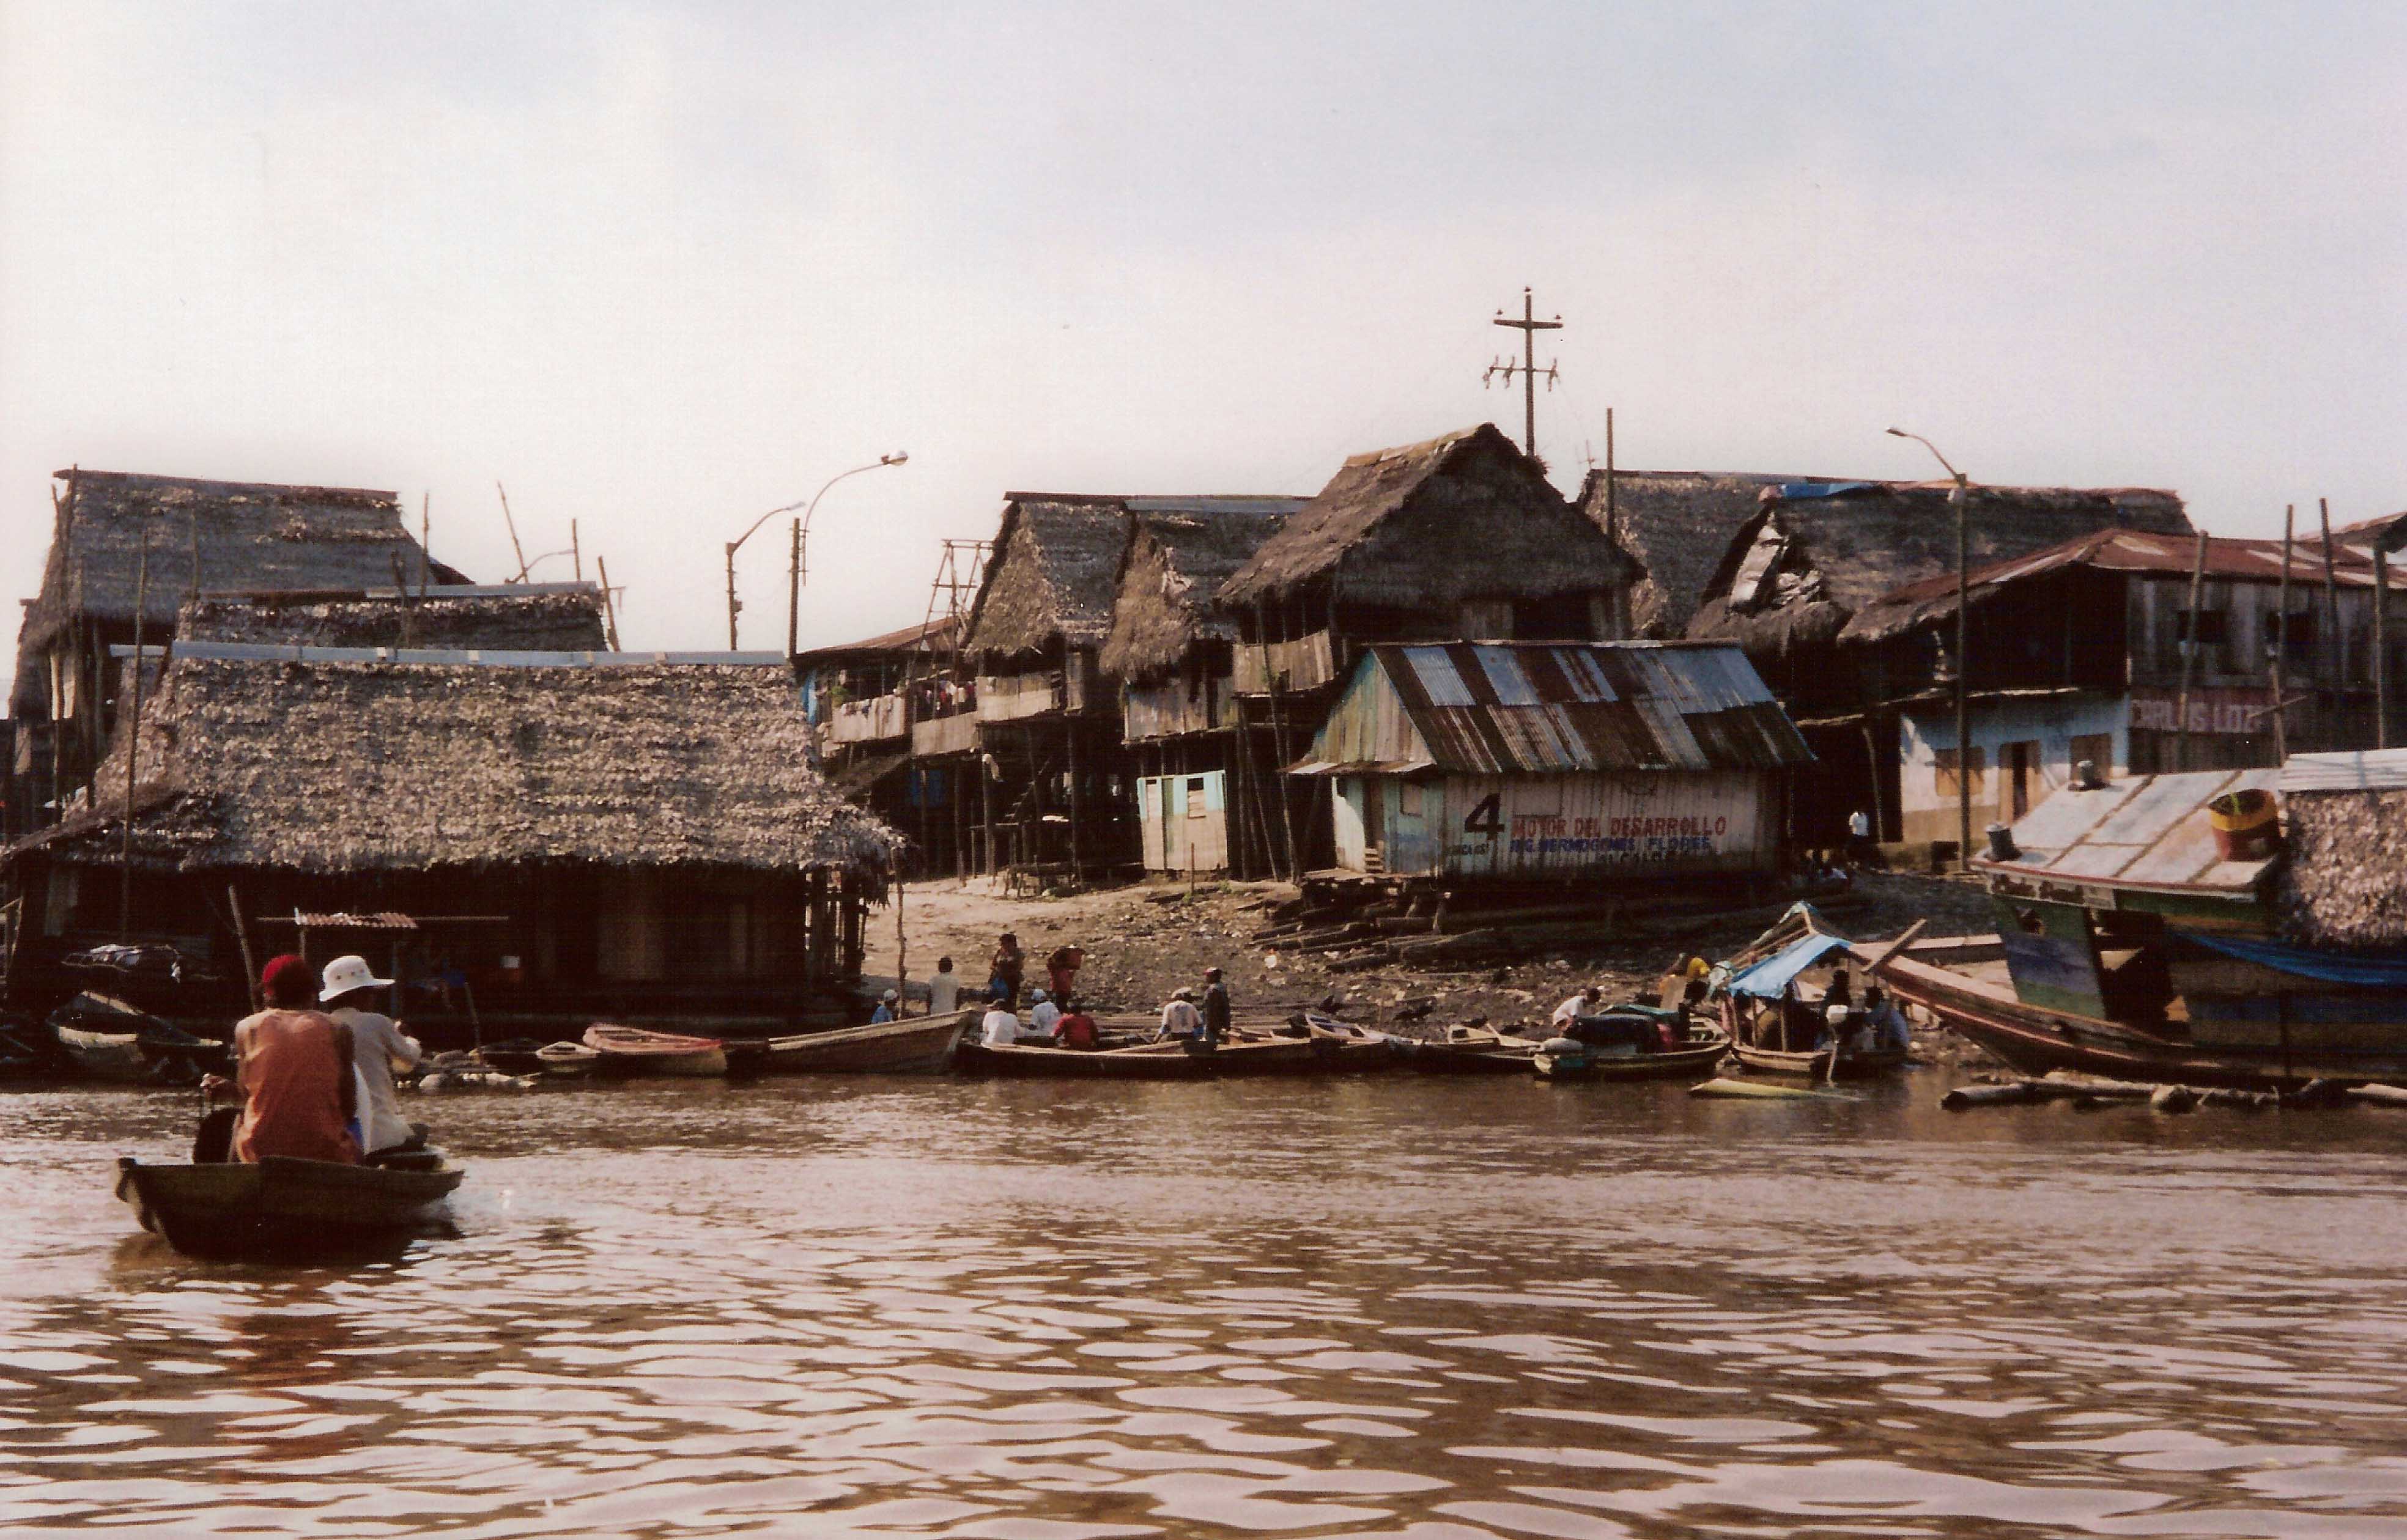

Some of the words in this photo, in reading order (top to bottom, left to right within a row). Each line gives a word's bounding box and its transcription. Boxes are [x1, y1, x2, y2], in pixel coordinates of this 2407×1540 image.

[1465, 792, 1504, 841] 4
[1511, 817, 1567, 838] MOTOR
[1575, 817, 1601, 837] DEL
[1610, 816, 1726, 836] DESARROLLO
